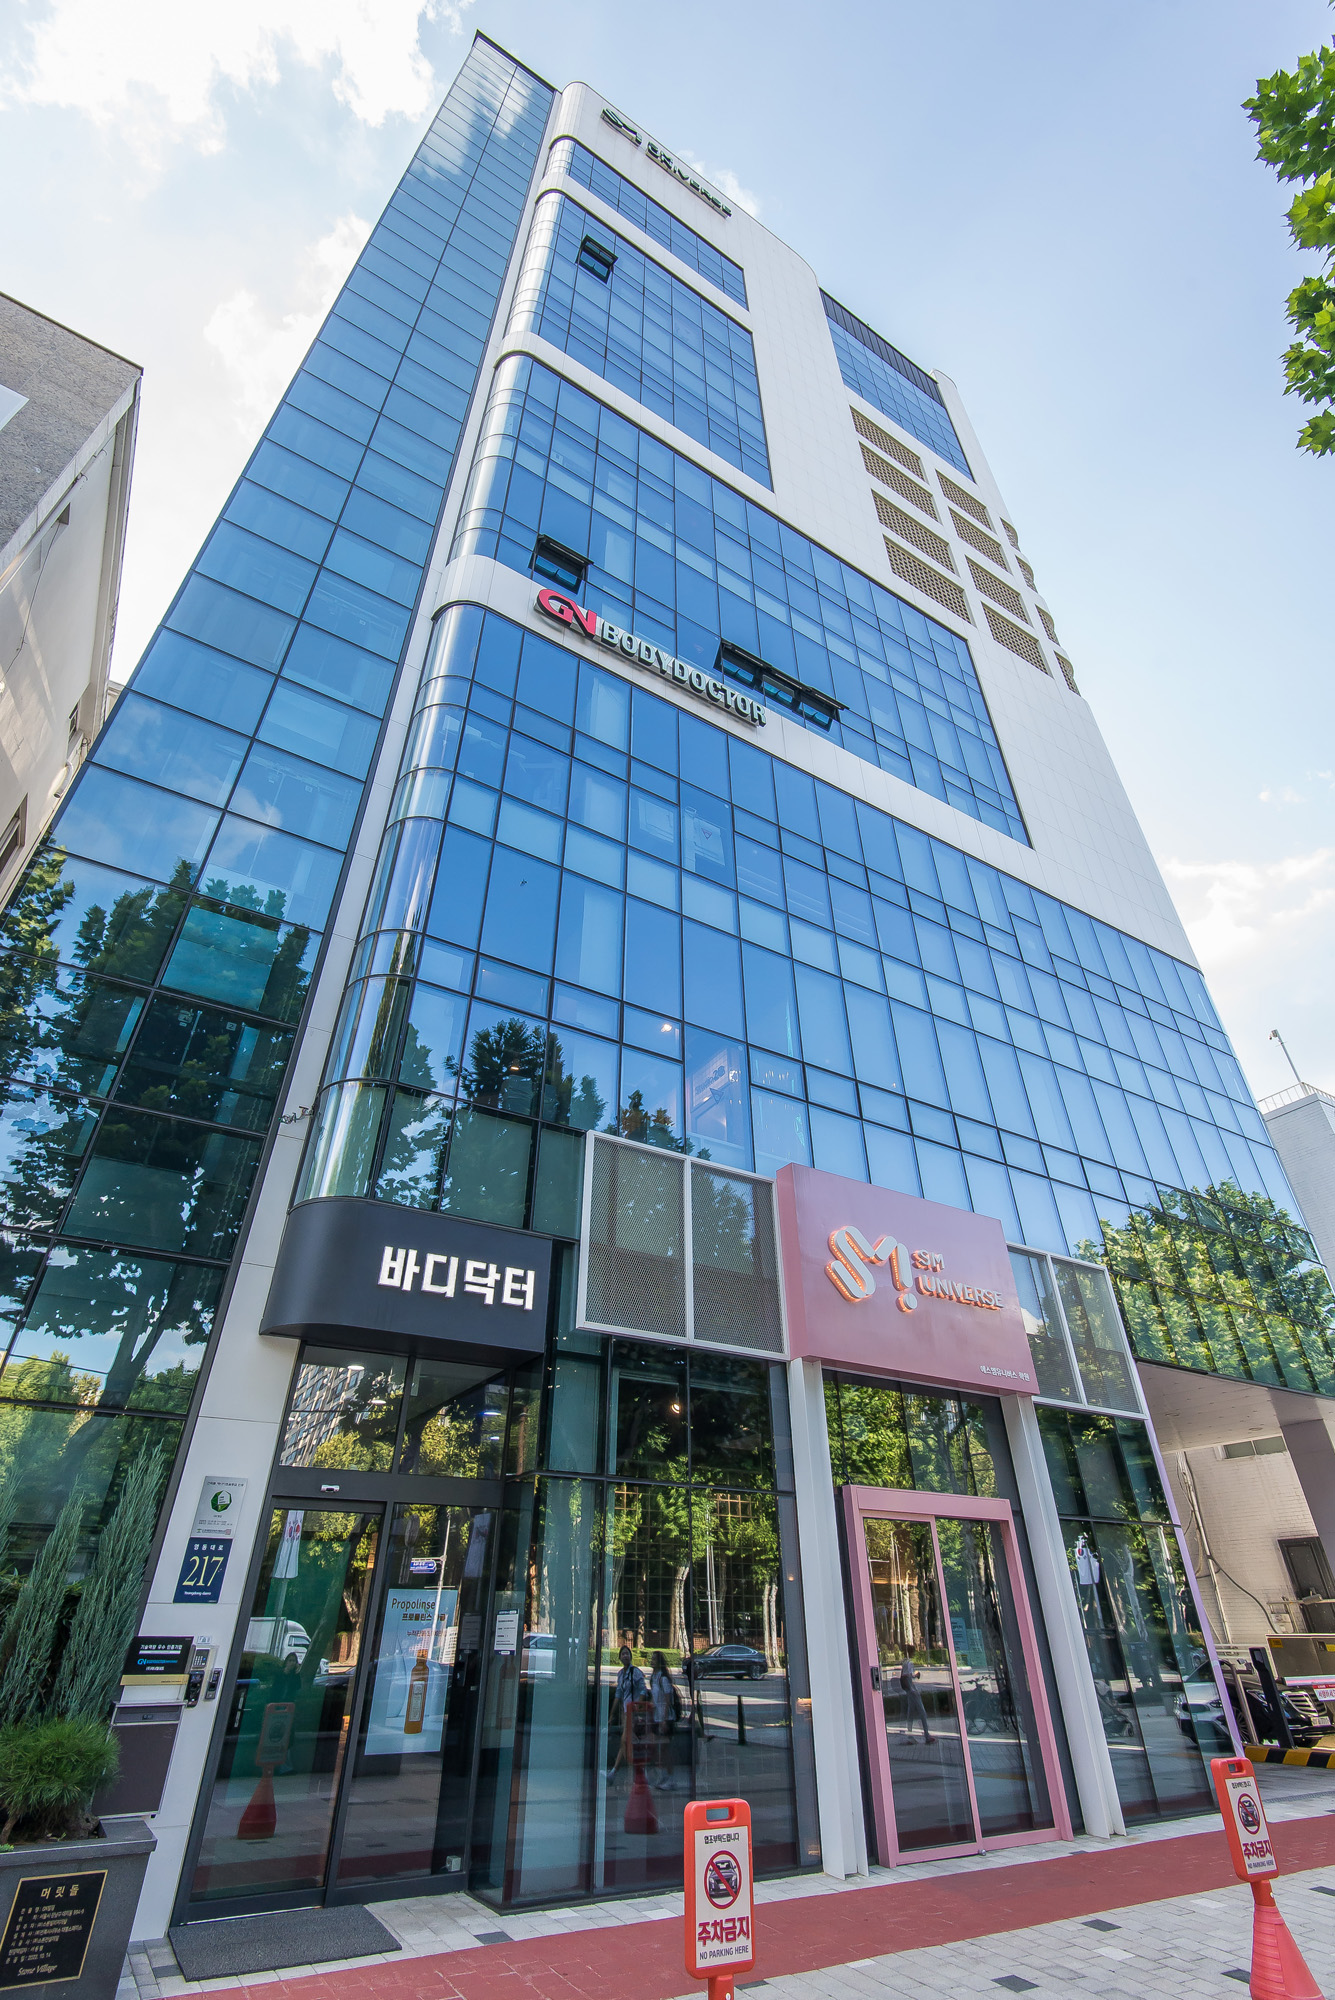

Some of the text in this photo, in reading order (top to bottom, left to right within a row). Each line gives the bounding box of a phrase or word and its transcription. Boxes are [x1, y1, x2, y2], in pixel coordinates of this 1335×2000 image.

[536, 588, 767, 727] GN BODYDOCTOR
[915, 1249, 945, 1272] SM
[377, 1245, 536, 1311] 바디닥터
[916, 1274, 1004, 1310] UNIVERSE
[980, 1365, 1031, 1382] 에스엠유니버스 학원
[193, 1543, 224, 1551] 영동대로
[182, 1555, 224, 1586] 217
[391, 1597, 436, 1612] Propolinse
[704, 1832, 740, 1844] 협조부탁드립니다
[1242, 1839, 1272, 1860] 주차금지
[697, 1916, 750, 1946] 주차금지
[700, 1945, 749, 1961] NO PARKING HERE
